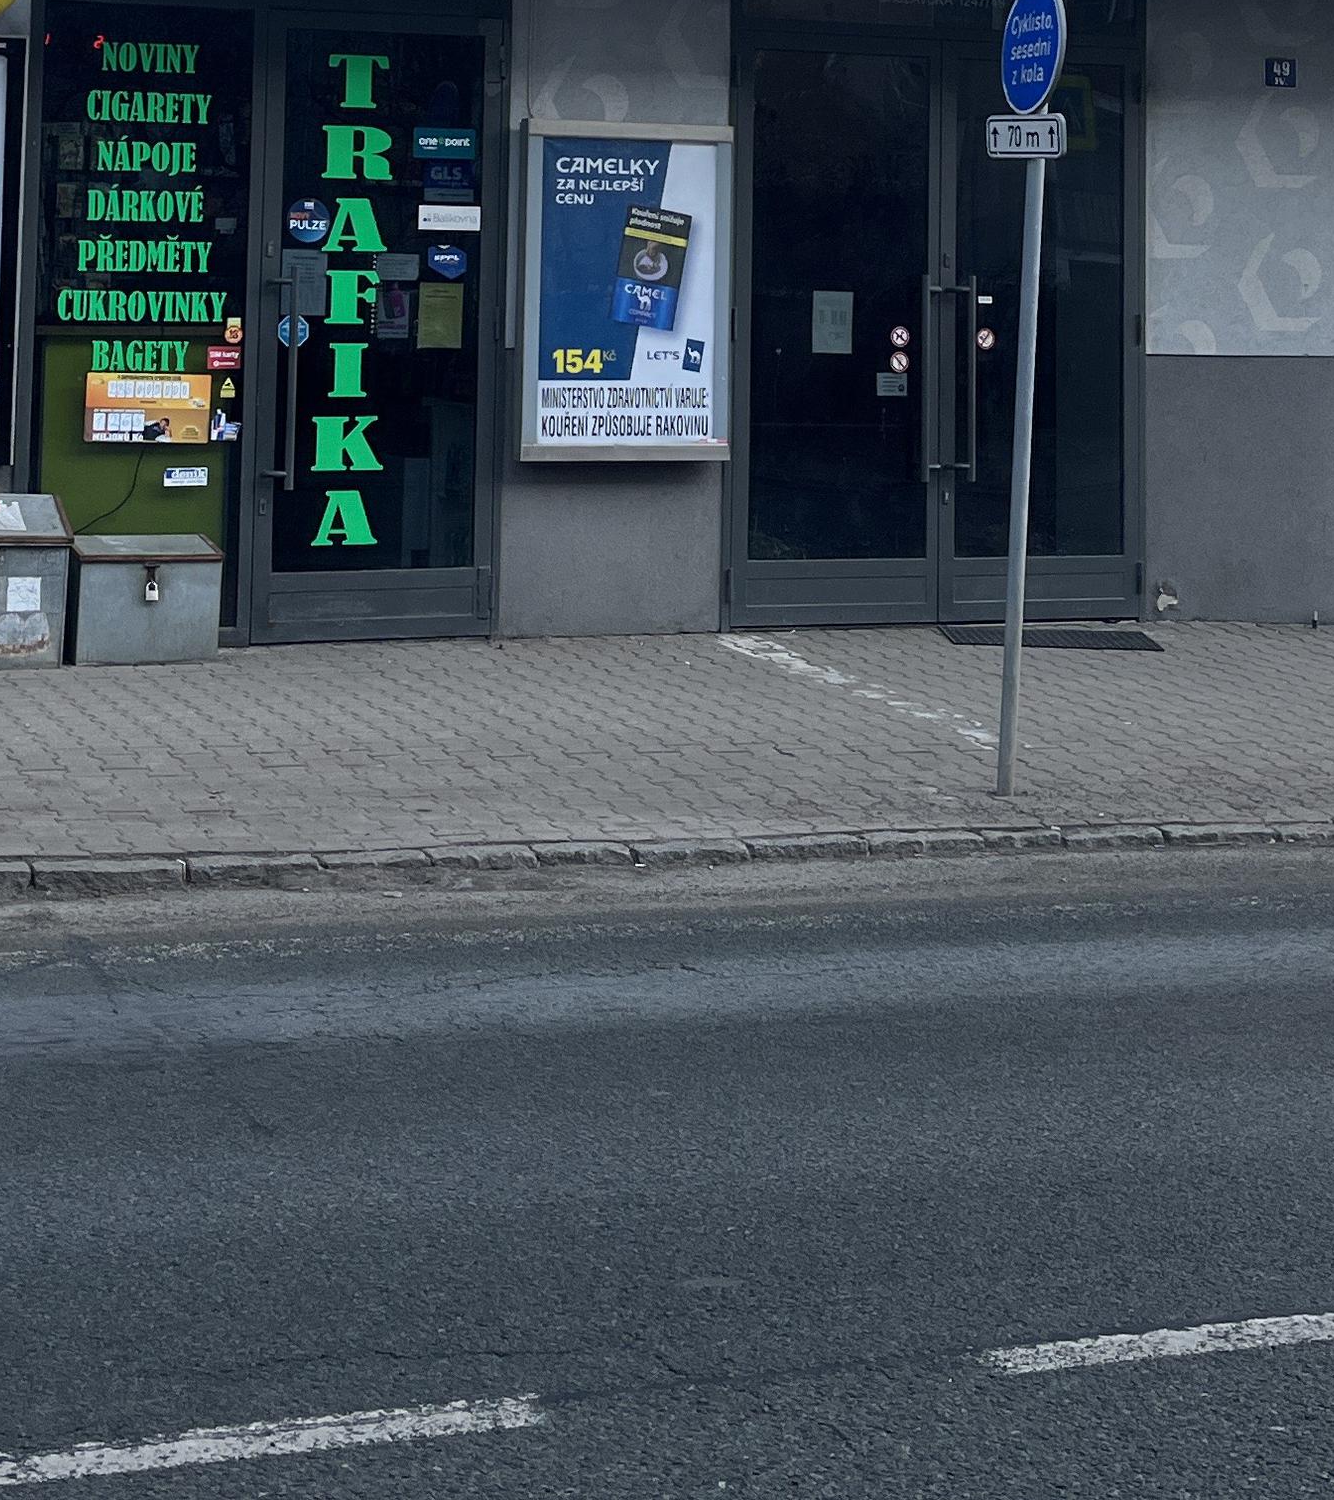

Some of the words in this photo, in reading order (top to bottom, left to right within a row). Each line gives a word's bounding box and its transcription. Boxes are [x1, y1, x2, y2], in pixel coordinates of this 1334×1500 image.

[101, 41, 200, 74] NOVINY
[1010, 36, 1052, 61] sesedni
[1011, 69, 1018, 86] z
[1019, 61, 1045, 85] kola
[1273, 60, 1291, 77] 49
[86, 89, 213, 125] CIGARETY
[1008, 124, 1022, 148] 70
[1025, 130, 1040, 148] m
[96, 134, 198, 177] NÁPOJE
[555, 156, 660, 176] CAMELKY
[430, 165, 463, 181] GLS
[556, 178, 576, 190] ZA
[579, 177, 645, 192] NEJLEPŠÍ
[86, 183, 205, 223] DÁRKOVÉ
[555, 193, 595, 205] CENU
[289, 219, 327, 231] PULZE
[77, 233, 213, 273] PŘEDMĚTY
[310, 53, 394, 547] TRAFIKA
[624, 283, 667, 301] CAMEL
[57, 288, 228, 323] CUKROVINKY
[91, 339, 190, 372] BAGETY
[552, 348, 604, 374] 154
[602, 349, 617, 362] Kč
[541, 386, 605, 409] MINISTERSTVO
[607, 383, 673, 409] ZDRAVOTNICTVÍ
[674, 386, 709, 408] VARUJE:
[541, 411, 590, 438] KOUŘENÍ
[591, 410, 652, 437] ZPŮSOBUJE
[655, 415, 709, 437] RAKOVINU
